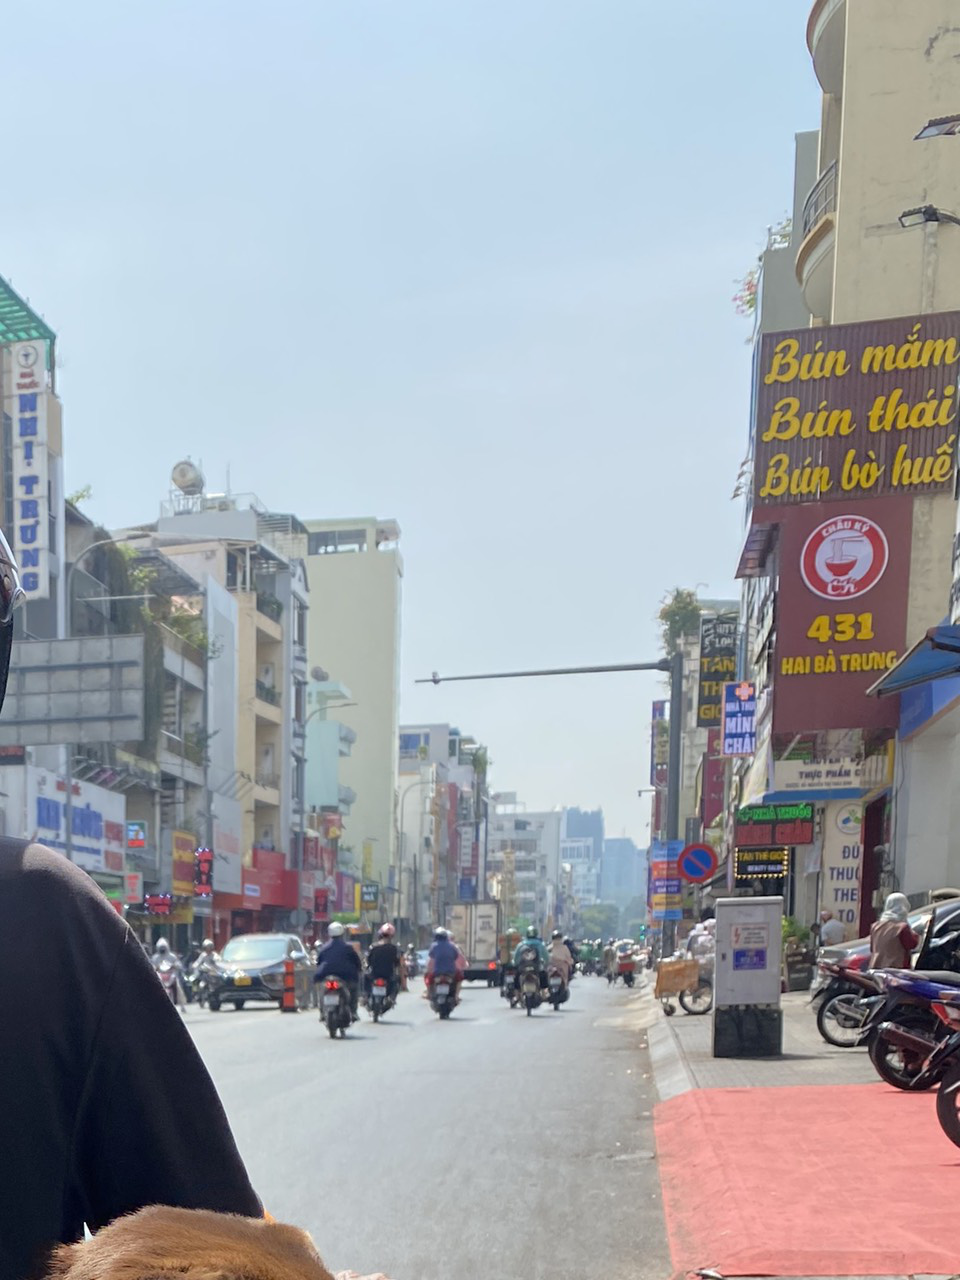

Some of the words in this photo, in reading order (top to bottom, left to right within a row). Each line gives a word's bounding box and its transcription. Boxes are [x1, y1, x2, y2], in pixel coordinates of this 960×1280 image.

[764, 338, 851, 385] Bún
[860, 322, 960, 375] mắm
[762, 396, 856, 443] Bún
[868, 384, 956, 433] thái
[759, 453, 833, 497] Bún
[841, 448, 886, 491] bò
[891, 434, 956, 487] huế
[806, 612, 875, 643] 431
[781, 655, 811, 675] HAI
[814, 649, 837, 673] BÀ
[840, 650, 898, 673] TRƯNG
